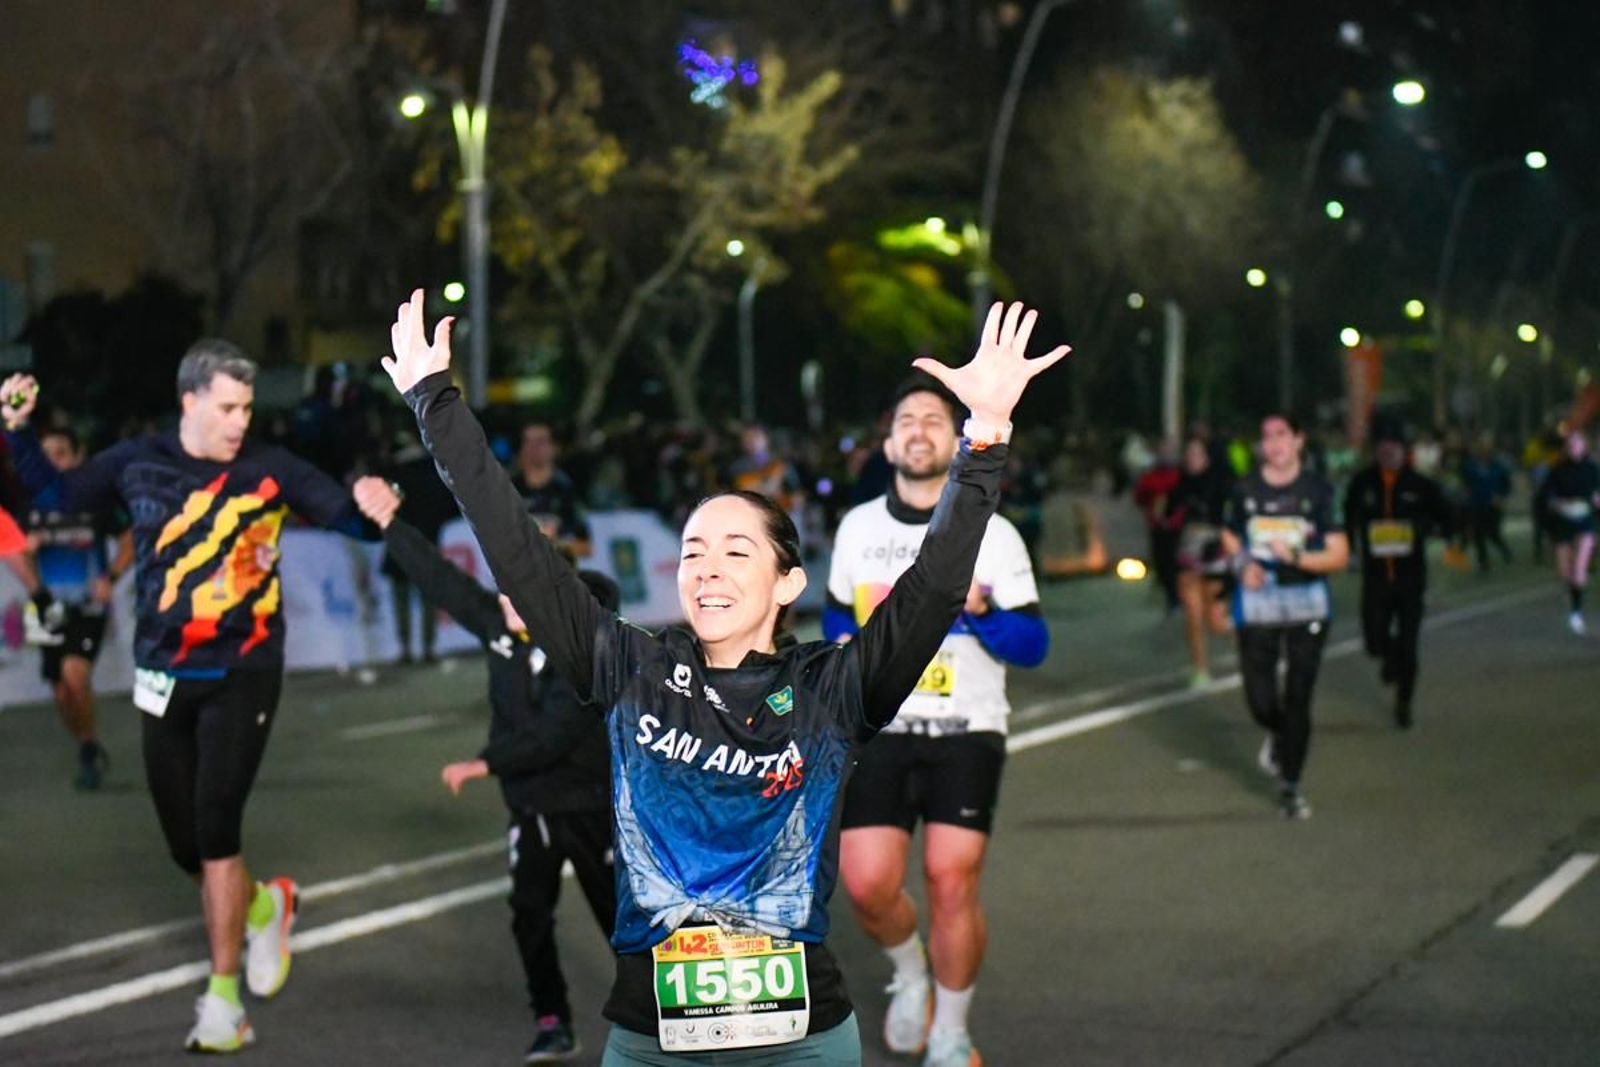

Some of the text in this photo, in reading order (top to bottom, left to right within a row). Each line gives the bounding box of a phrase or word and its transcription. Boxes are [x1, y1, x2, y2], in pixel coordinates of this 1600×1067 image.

[636, 714, 702, 764] SAN
[679, 934, 708, 954] 42
[665, 956, 794, 1004] 1550
[683, 1007, 714, 1016] VANESSA
